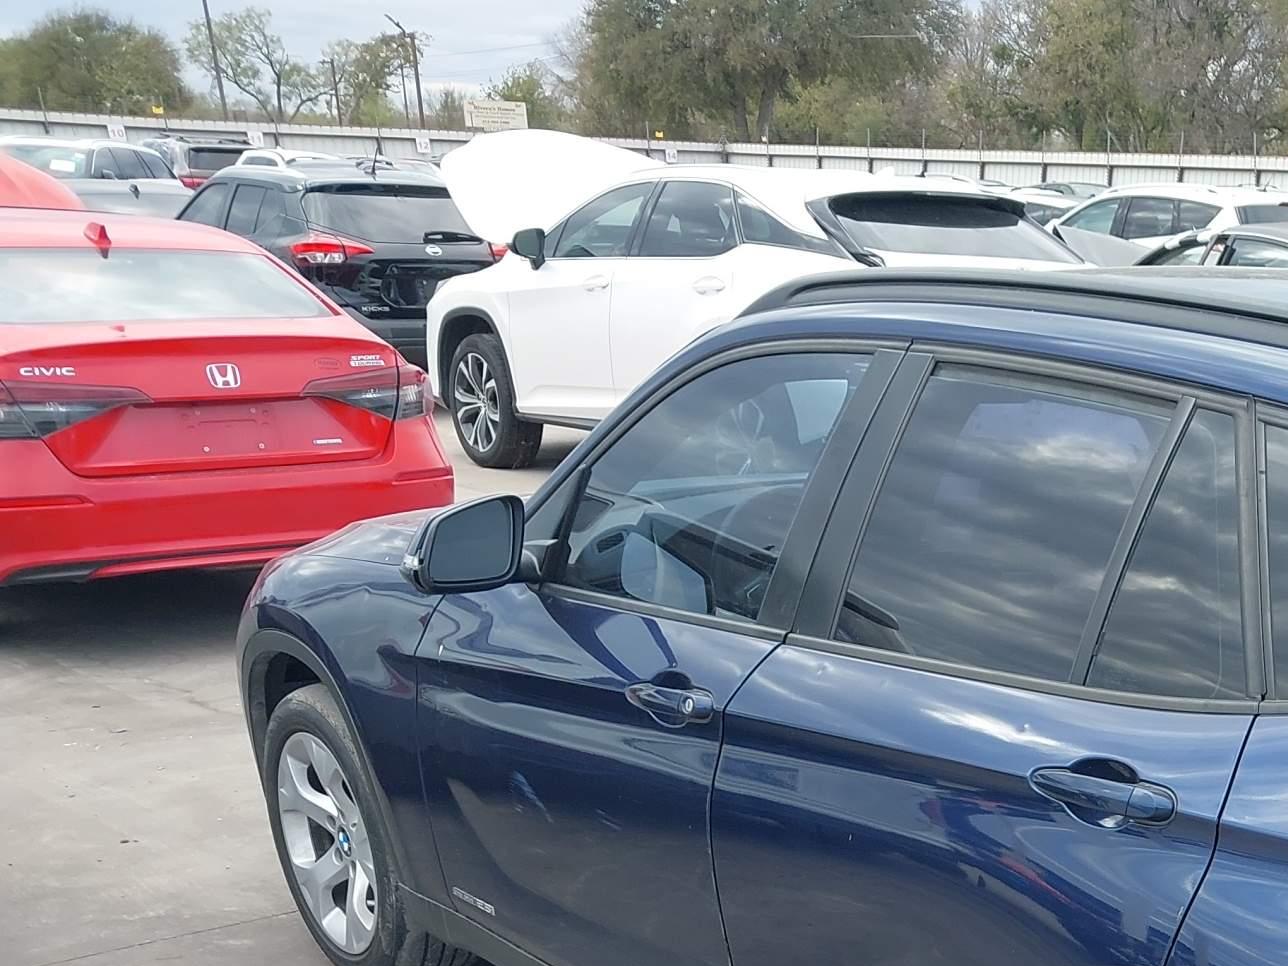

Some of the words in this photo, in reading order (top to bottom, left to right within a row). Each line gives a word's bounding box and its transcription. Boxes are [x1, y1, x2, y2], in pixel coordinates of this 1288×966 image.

[111, 129, 124, 138] 10
[418, 141, 429, 150] 12
[667, 151, 676, 160] 14
[19, 366, 76, 376] CIVIC
